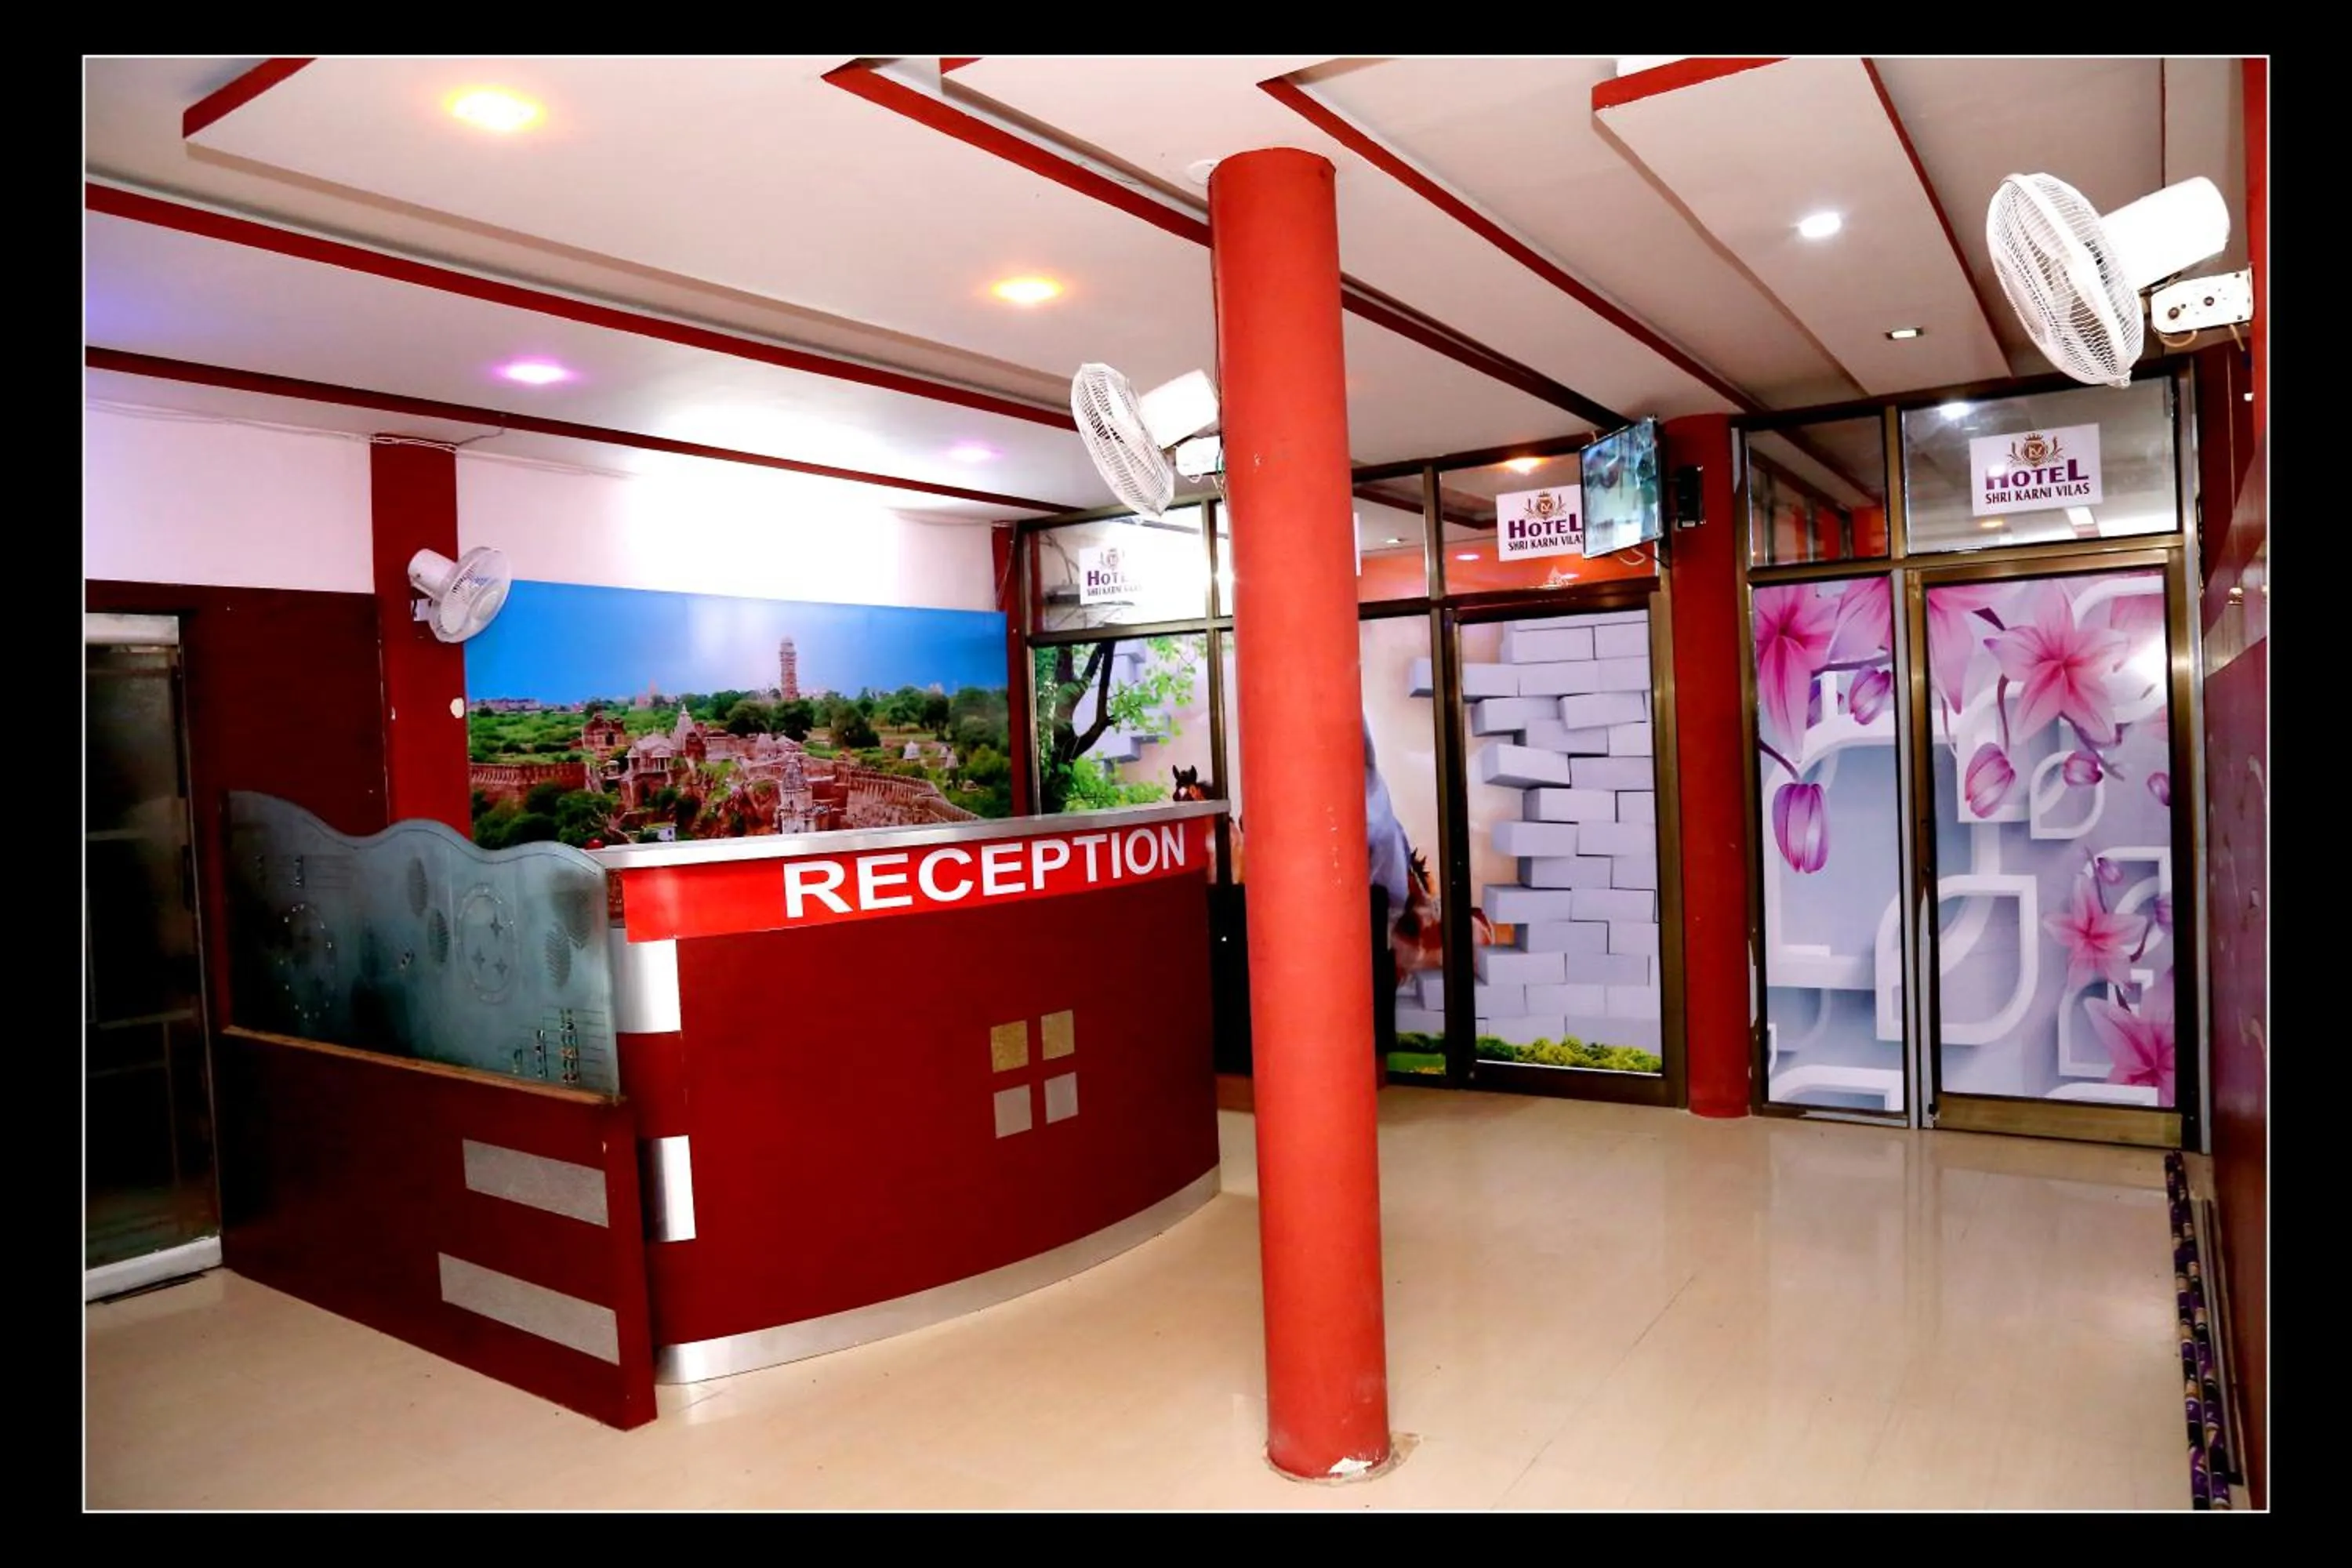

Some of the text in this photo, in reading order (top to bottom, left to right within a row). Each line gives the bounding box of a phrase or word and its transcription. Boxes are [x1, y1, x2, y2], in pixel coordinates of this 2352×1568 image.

[1986, 459, 2089, 490] HOTEL
[1986, 483, 2090, 504] SHRI KARNI VILAS
[1508, 514, 1583, 539] HOTEL
[1508, 540, 1528, 551] SHRI
[1530, 537, 1558, 549] KARNI
[784, 823, 1185, 918] RECEPTION
